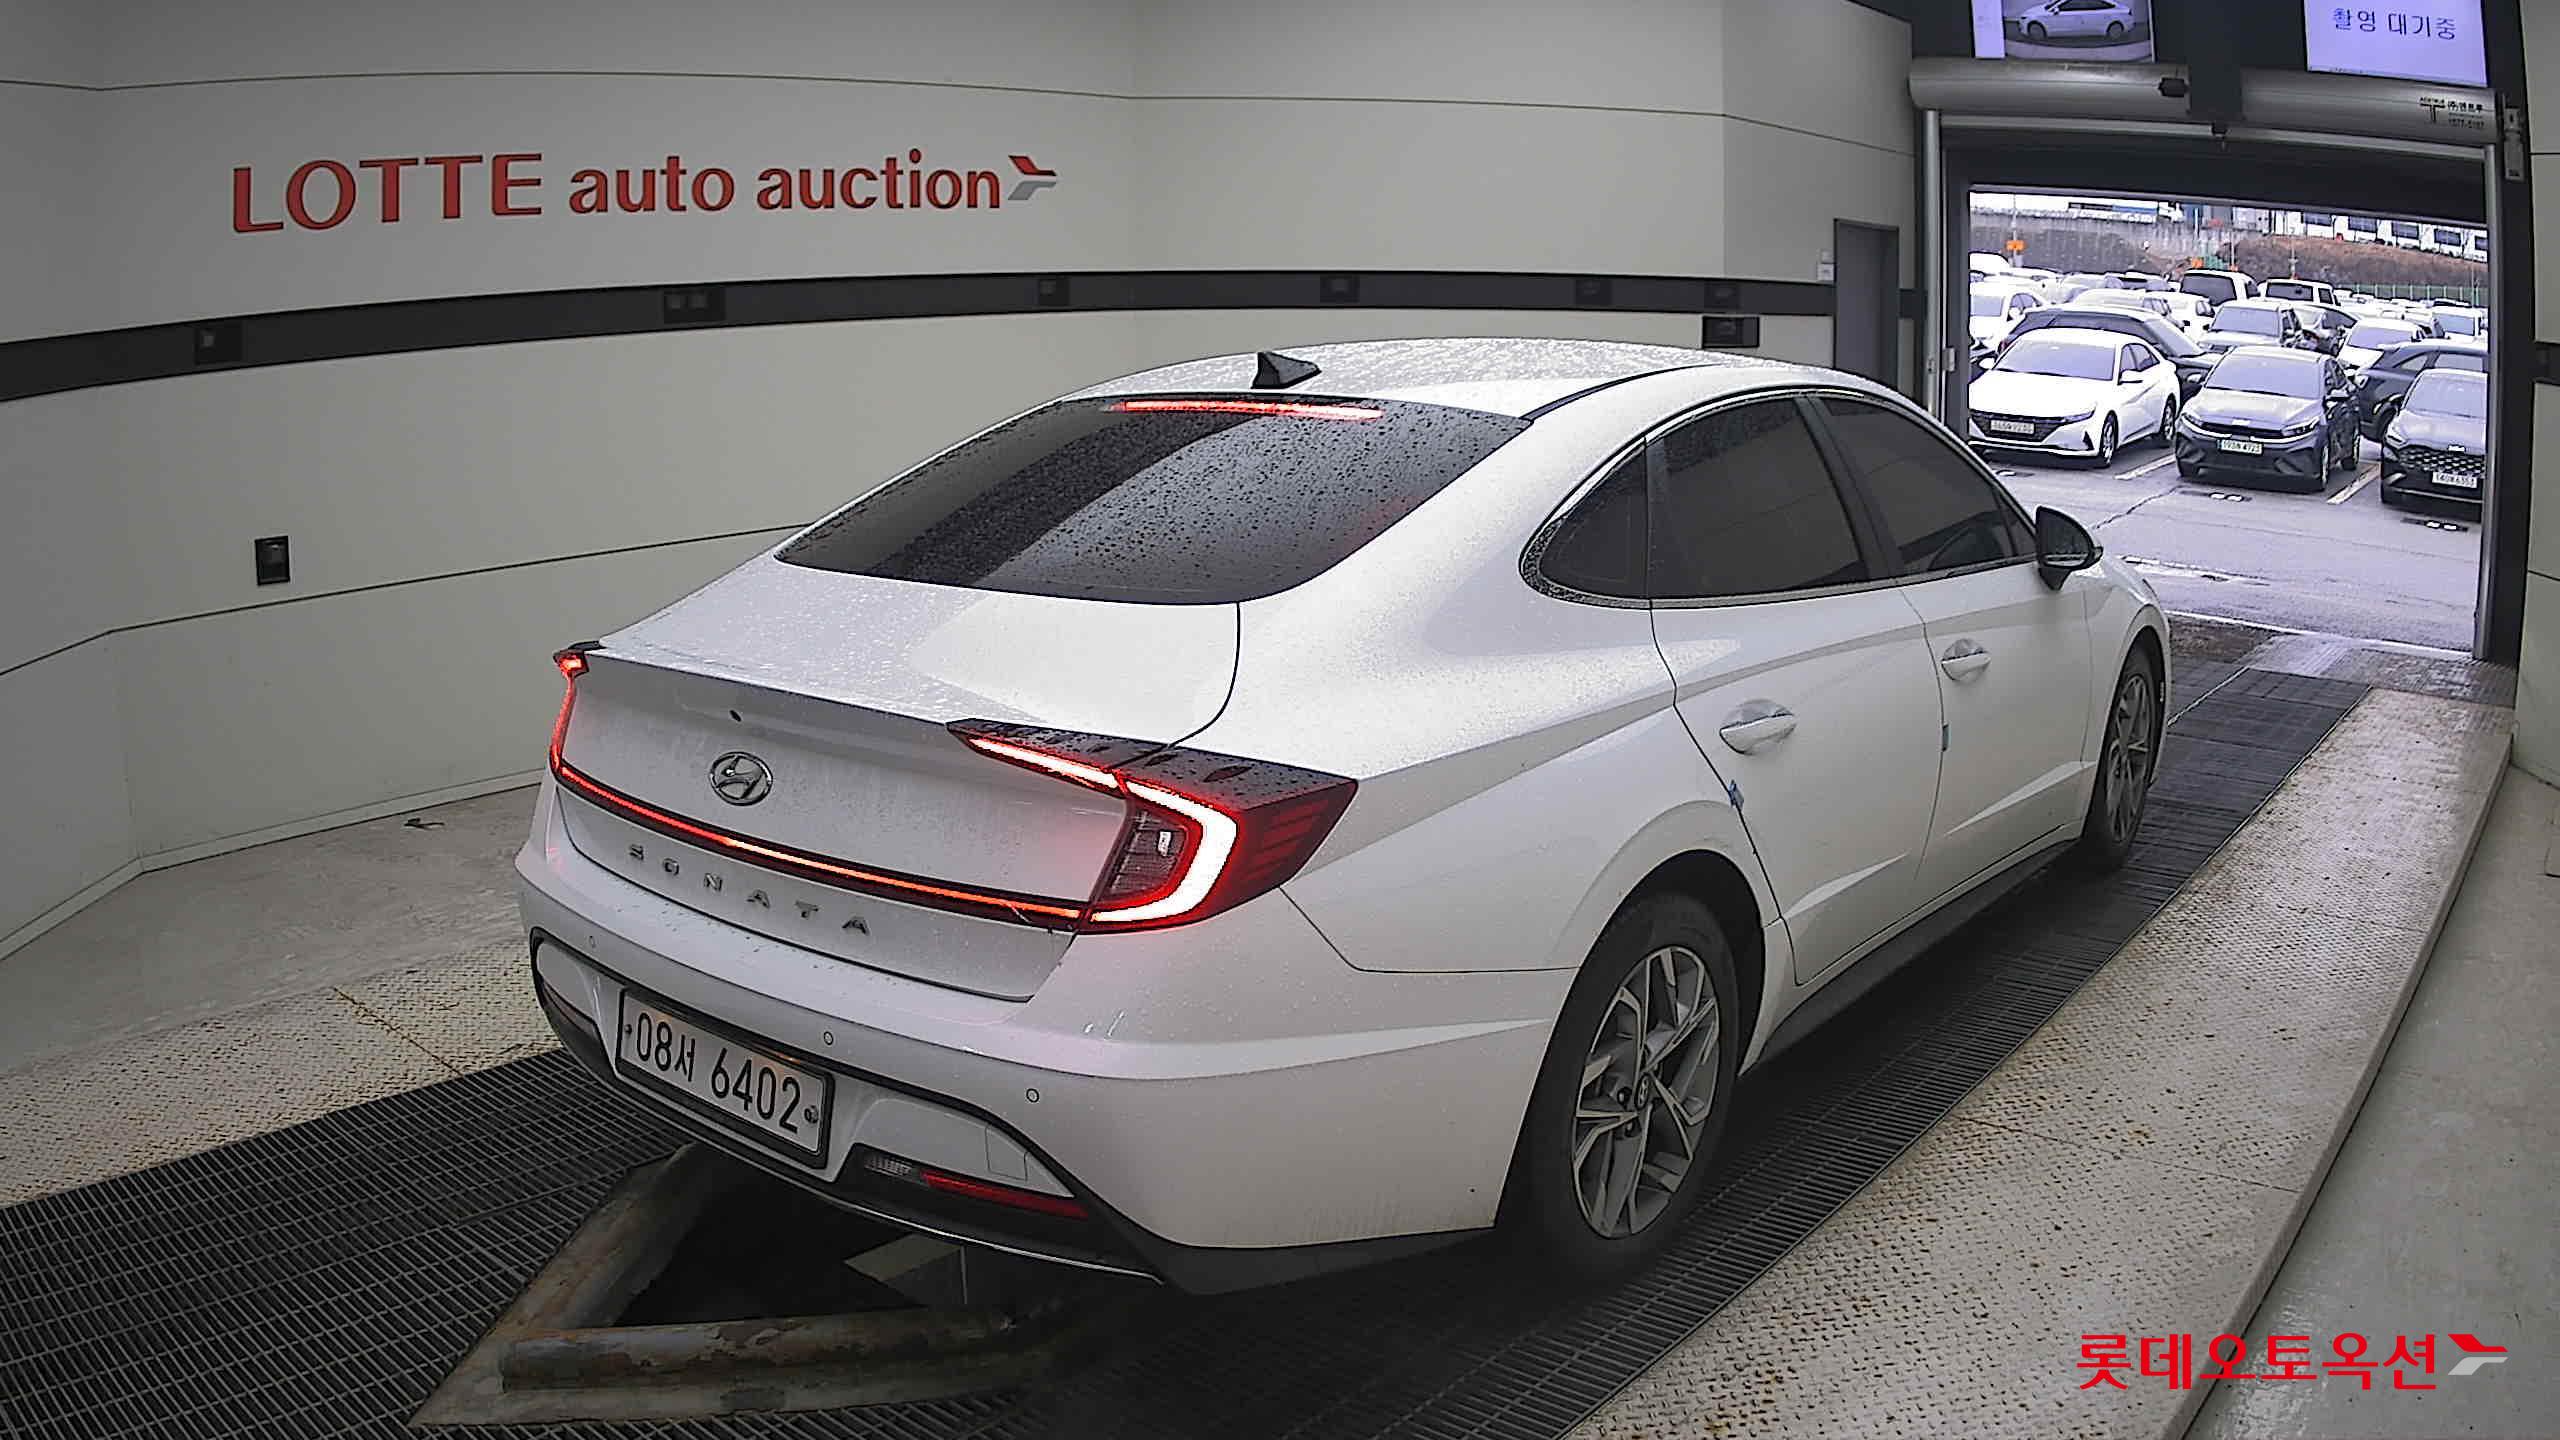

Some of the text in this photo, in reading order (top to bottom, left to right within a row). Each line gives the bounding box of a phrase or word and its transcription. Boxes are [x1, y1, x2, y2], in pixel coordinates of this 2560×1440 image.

[2333, 8, 2456, 41] 촬영 대기중
[232, 147, 1001, 233] LOTTE auto auction
[628, 843, 870, 936] SONATA
[636, 1011, 802, 1135] 08서 6402
